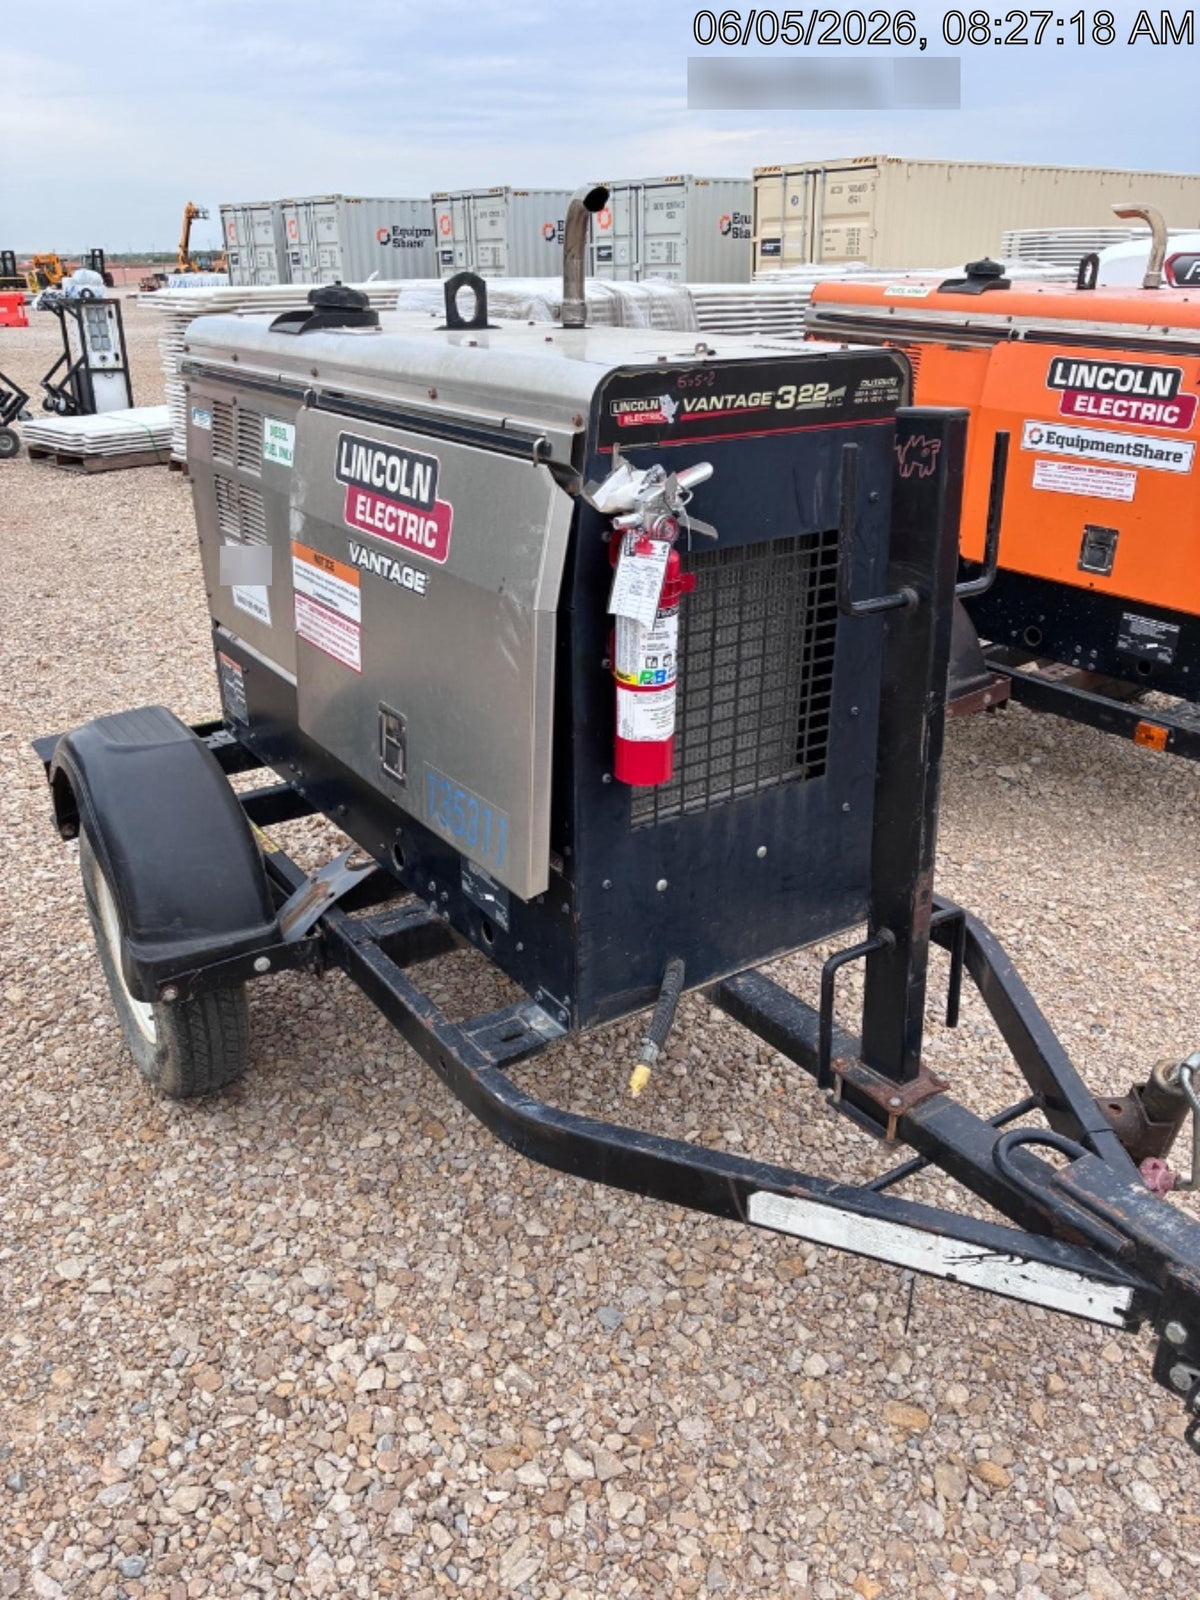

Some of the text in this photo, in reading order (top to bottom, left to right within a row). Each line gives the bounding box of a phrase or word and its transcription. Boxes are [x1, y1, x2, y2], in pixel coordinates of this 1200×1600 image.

[1053, 362, 1175, 397] LINCOLN
[612, 399, 660, 414] LINCOLN
[683, 392, 774, 412] VANTAGE
[775, 382, 830, 410] 322
[1073, 394, 1181, 424] ELECTRIC
[1045, 431, 1184, 464] EquipmentShare
[340, 441, 433, 503] LINCOLN
[355, 494, 439, 549] ELECTRIC
[349, 541, 428, 596] VANTAGE
